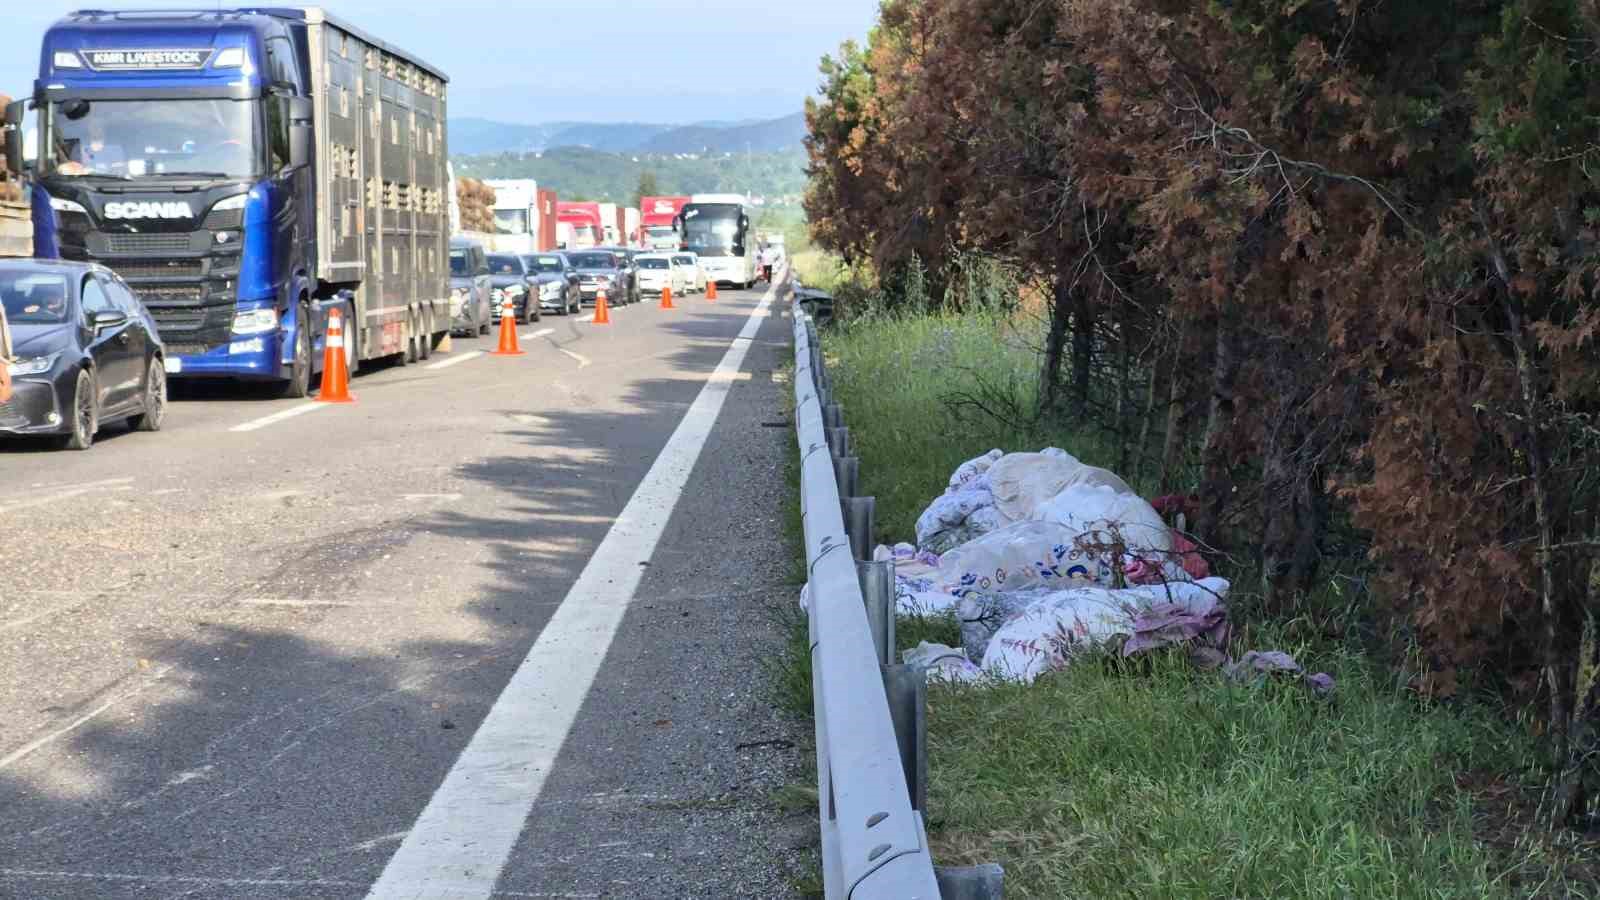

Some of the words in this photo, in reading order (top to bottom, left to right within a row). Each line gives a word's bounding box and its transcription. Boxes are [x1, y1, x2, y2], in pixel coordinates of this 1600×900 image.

[93, 52, 125, 63] KMR
[126, 52, 200, 63] LIVESTOCK
[104, 202, 193, 218] SCANIA
